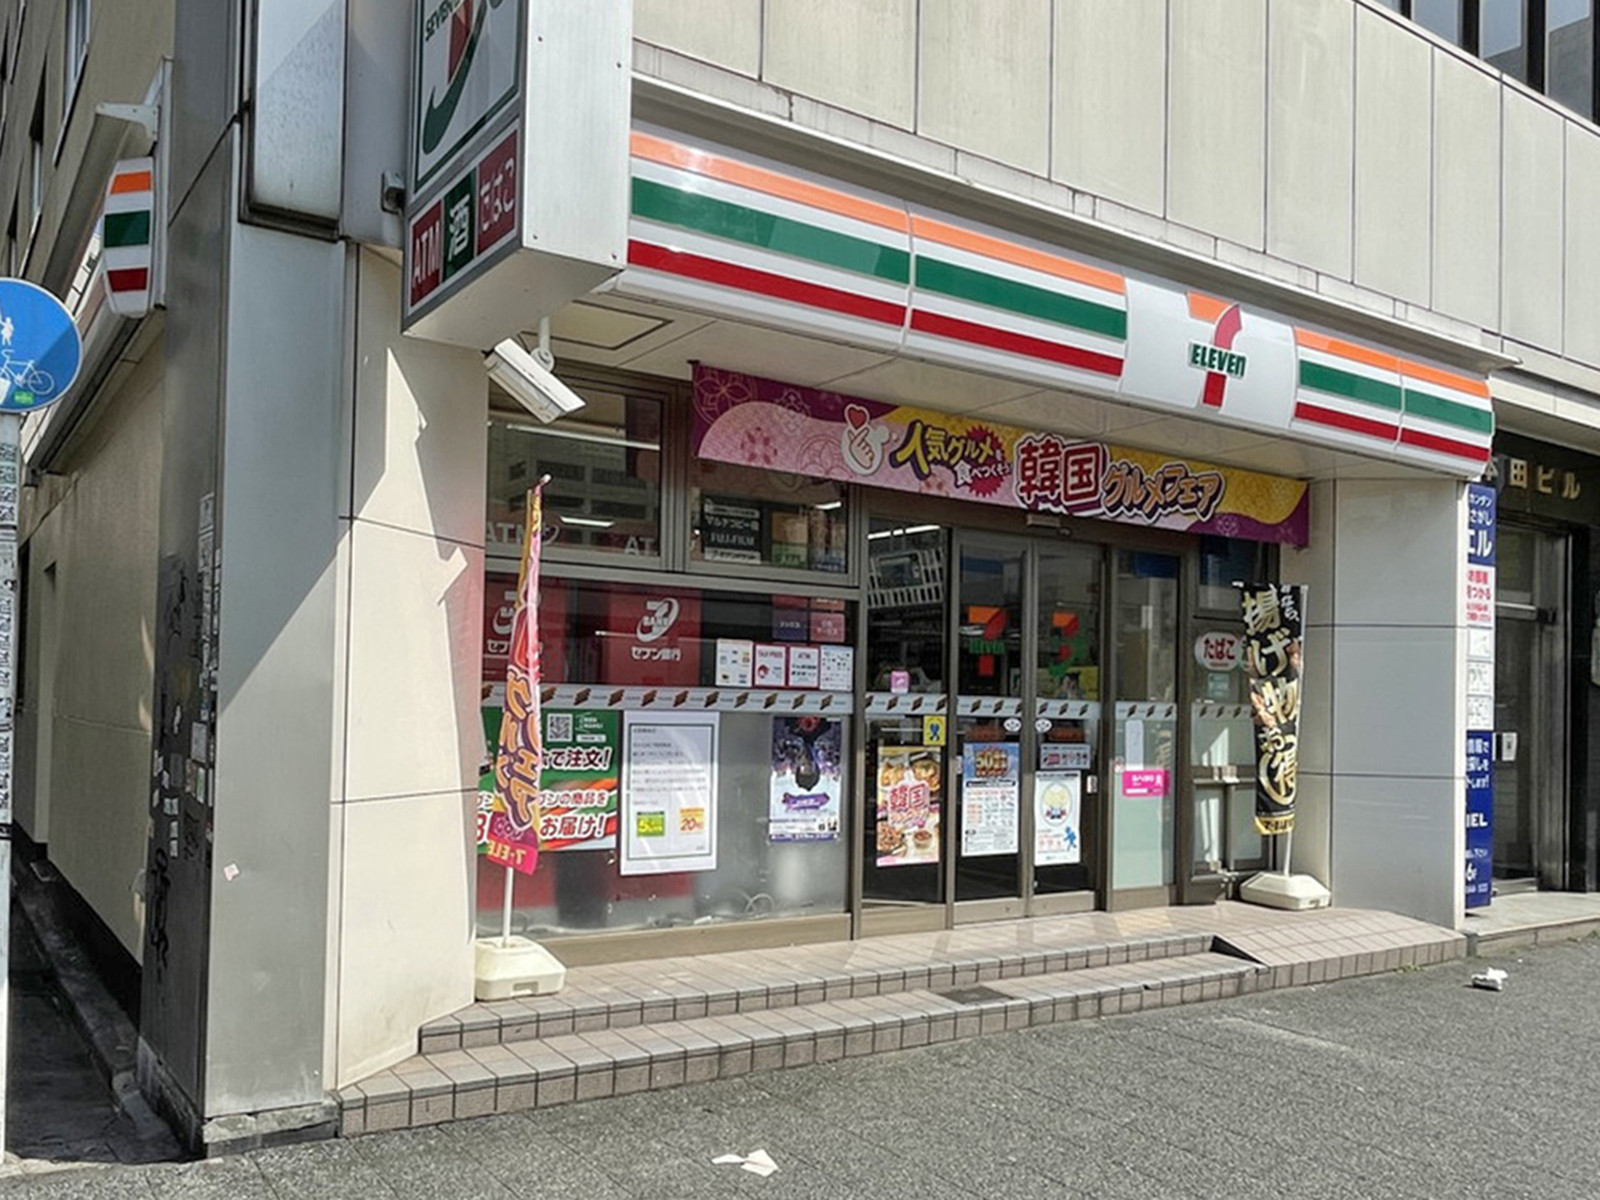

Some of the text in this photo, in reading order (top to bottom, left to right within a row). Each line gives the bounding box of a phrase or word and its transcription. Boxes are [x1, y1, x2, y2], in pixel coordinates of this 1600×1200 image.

[448, 194, 470, 261] 酒
[413, 218, 441, 285] ATM
[1204, 637, 1236, 661] たばこ
[540, 814, 605, 837] お届け!
